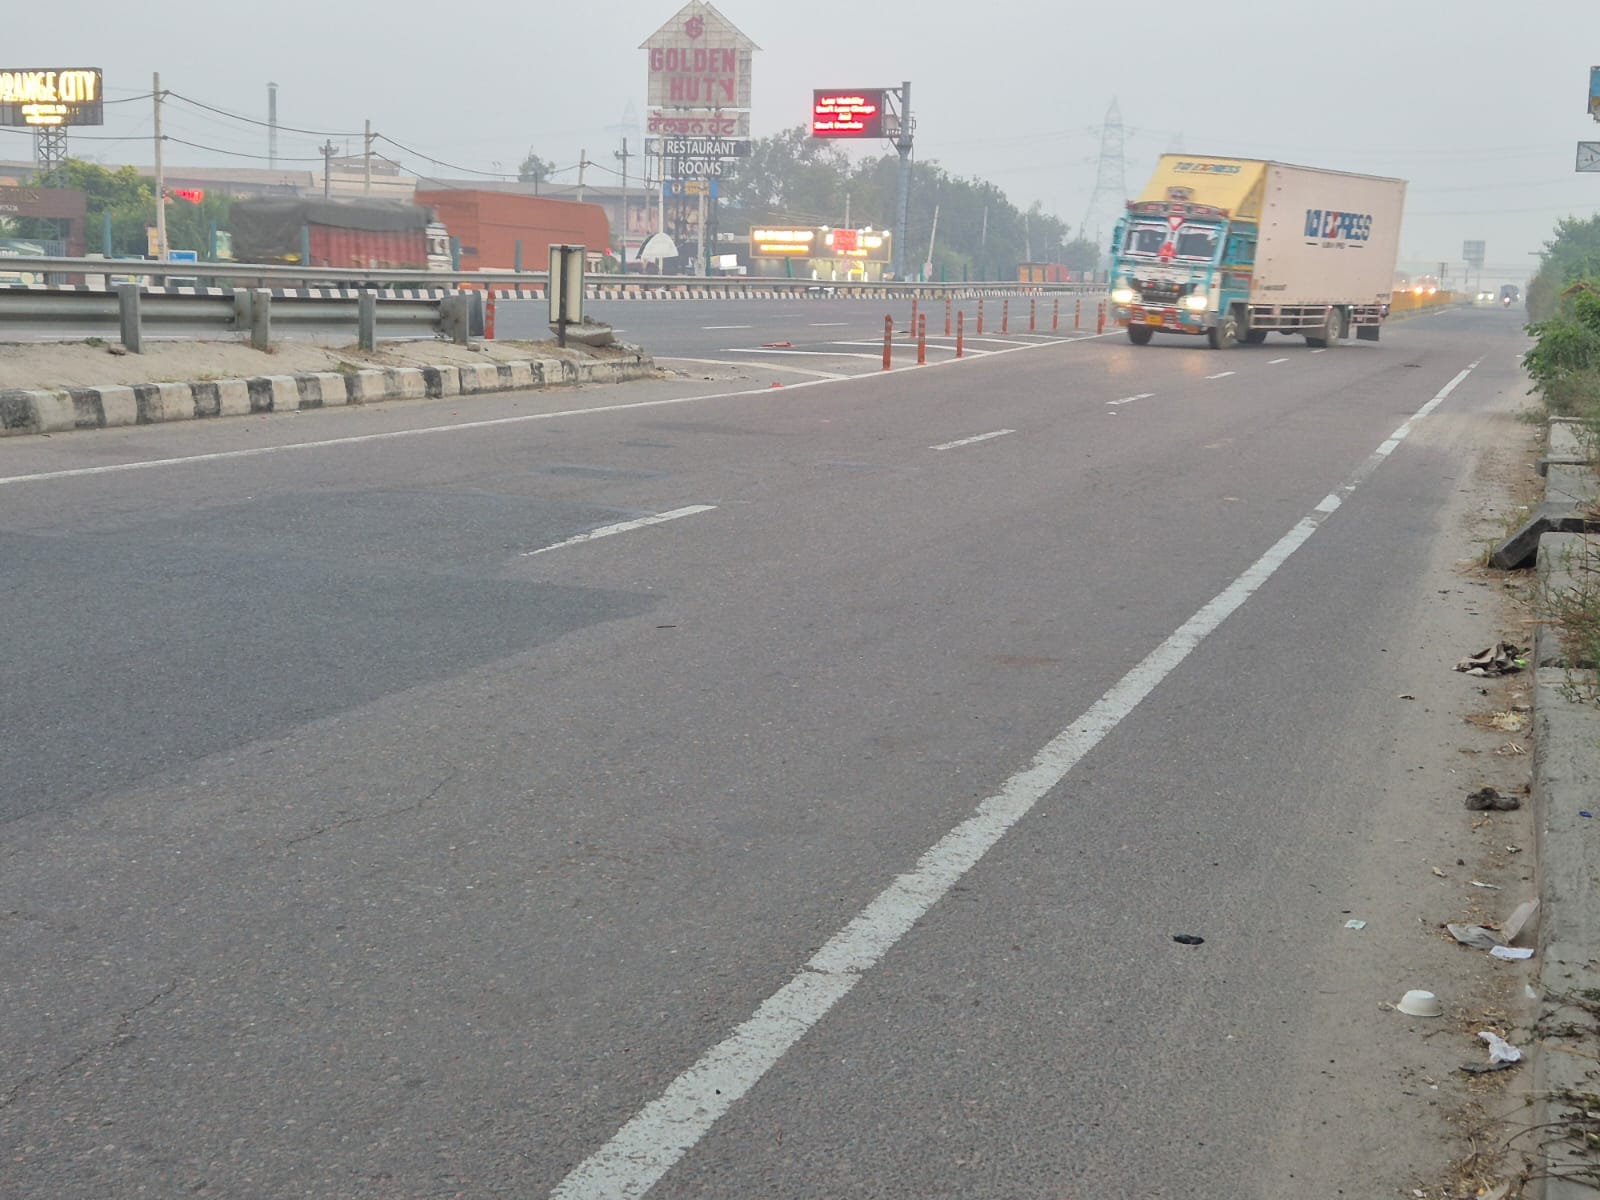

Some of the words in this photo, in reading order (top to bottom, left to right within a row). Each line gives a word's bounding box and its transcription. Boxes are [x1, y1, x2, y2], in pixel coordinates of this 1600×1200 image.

[651, 48, 736, 72] GOLDEN
[59, 71, 96, 102] CITY
[667, 141, 736, 155] RESTAURANT
[678, 161, 721, 175] ROOMS
